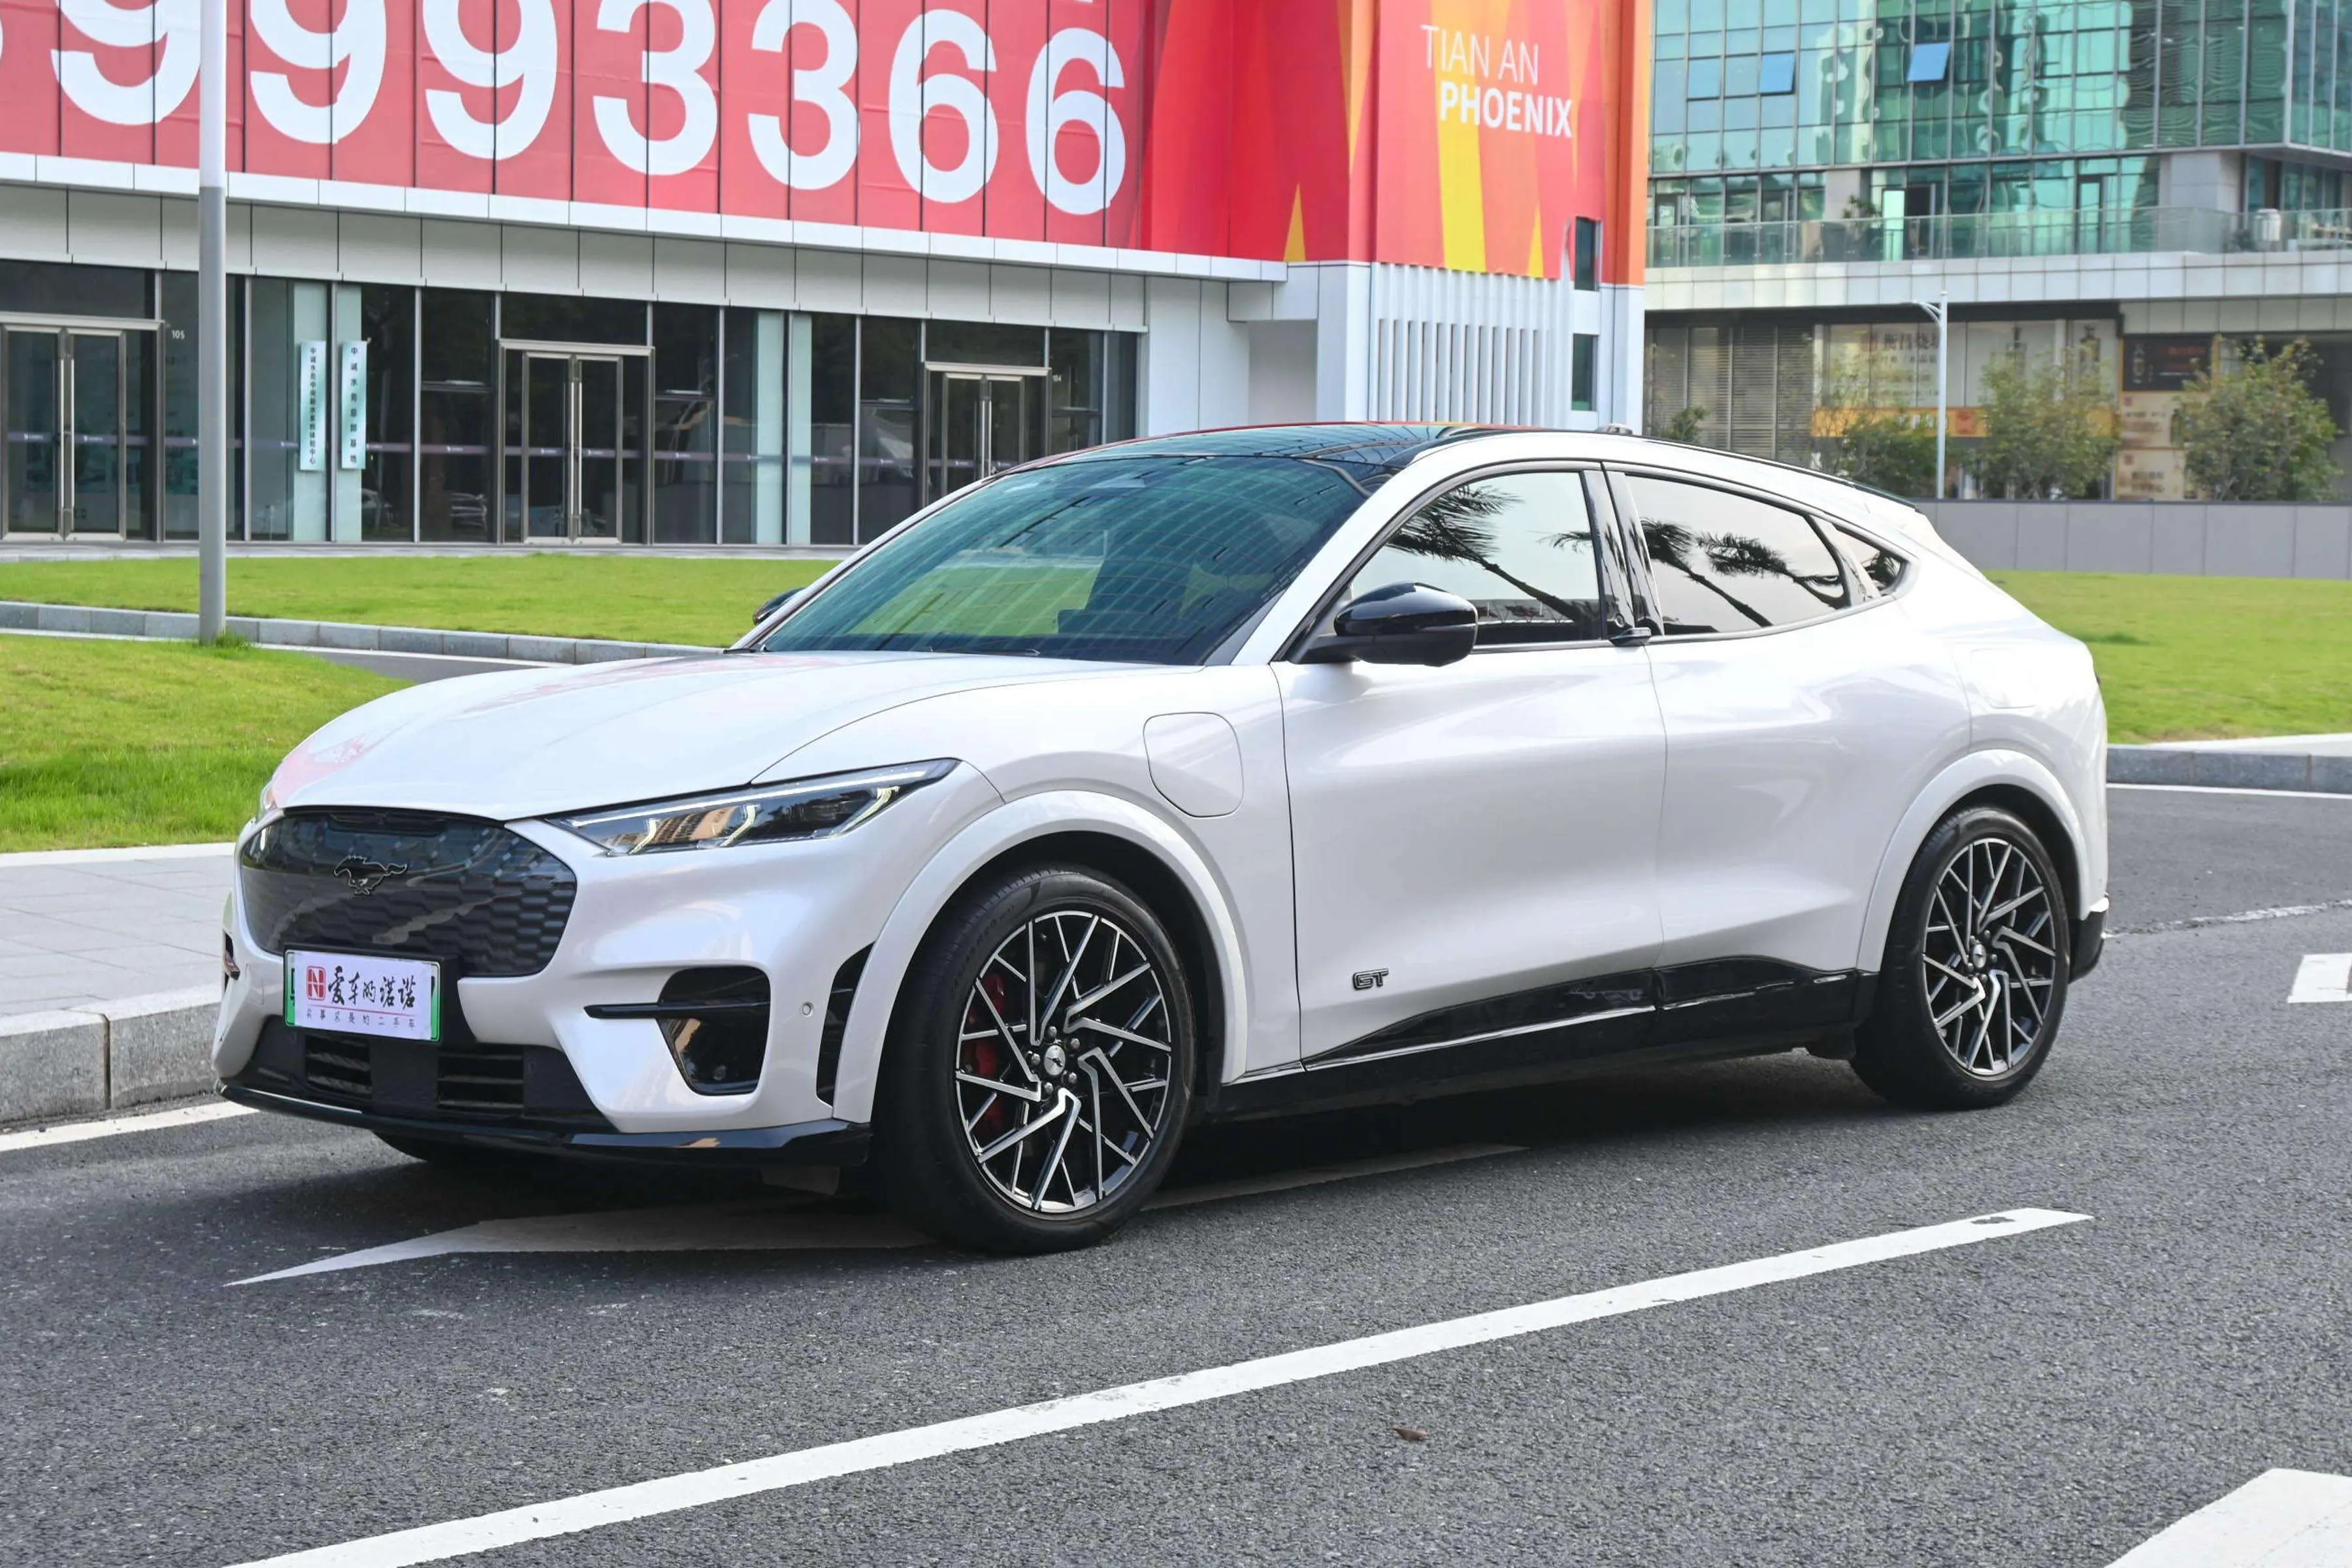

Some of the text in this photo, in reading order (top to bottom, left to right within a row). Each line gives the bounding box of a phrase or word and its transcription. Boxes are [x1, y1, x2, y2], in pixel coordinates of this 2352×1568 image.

[1420, 24, 1539, 86] TIAN AN
[0, 0, 1126, 215] 9993366
[1440, 81, 1573, 138] PHOENIX
[172, 329, 186, 340] 105
[1352, 968, 1389, 991] GT
